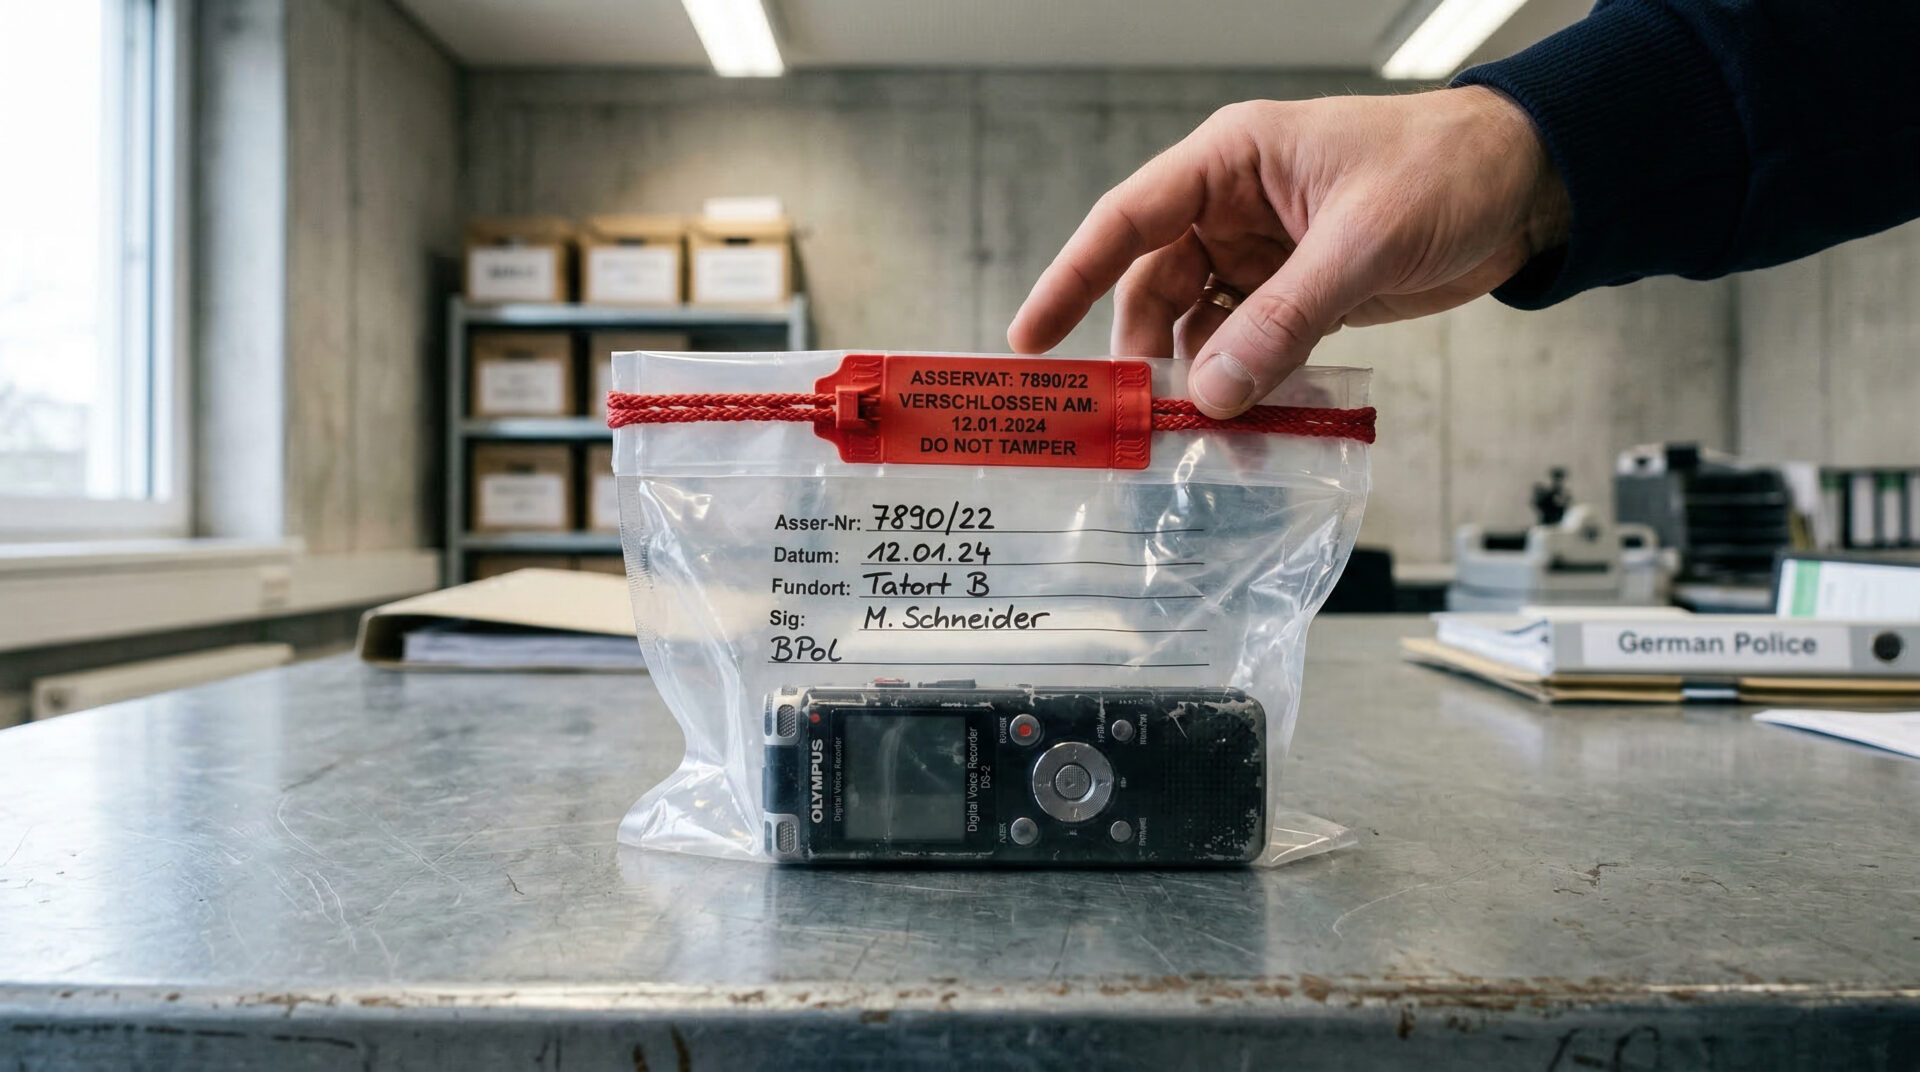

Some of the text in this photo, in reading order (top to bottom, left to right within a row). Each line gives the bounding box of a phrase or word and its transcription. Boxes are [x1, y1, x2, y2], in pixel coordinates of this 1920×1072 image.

[910, 370, 1089, 389] ASSERVAT: 7890/22
[899, 393, 1098, 413] VERSCHLOSSEN AM:
[951, 416, 1047, 433] 12.01.2024
[920, 438, 1077, 456] DO NOT TAMPER
[774, 514, 861, 531] Asser-Nr:
[872, 501, 995, 535] 7890/22
[774, 546, 839, 564] Datum:
[867, 541, 991, 565] 12.01.24
[771, 577, 850, 596] Fundort:
[862, 571, 990, 598] Tatort B
[769, 609, 805, 630] Sig:
[863, 604, 1050, 630] M. Schneider
[1618, 630, 1818, 655] German Police
[811, 738, 824, 824] OLYMPUS
[833, 771, 842, 794] Voice
[967, 727, 980, 832] Digital Voice Recorder
[980, 765, 991, 789] DS-2
